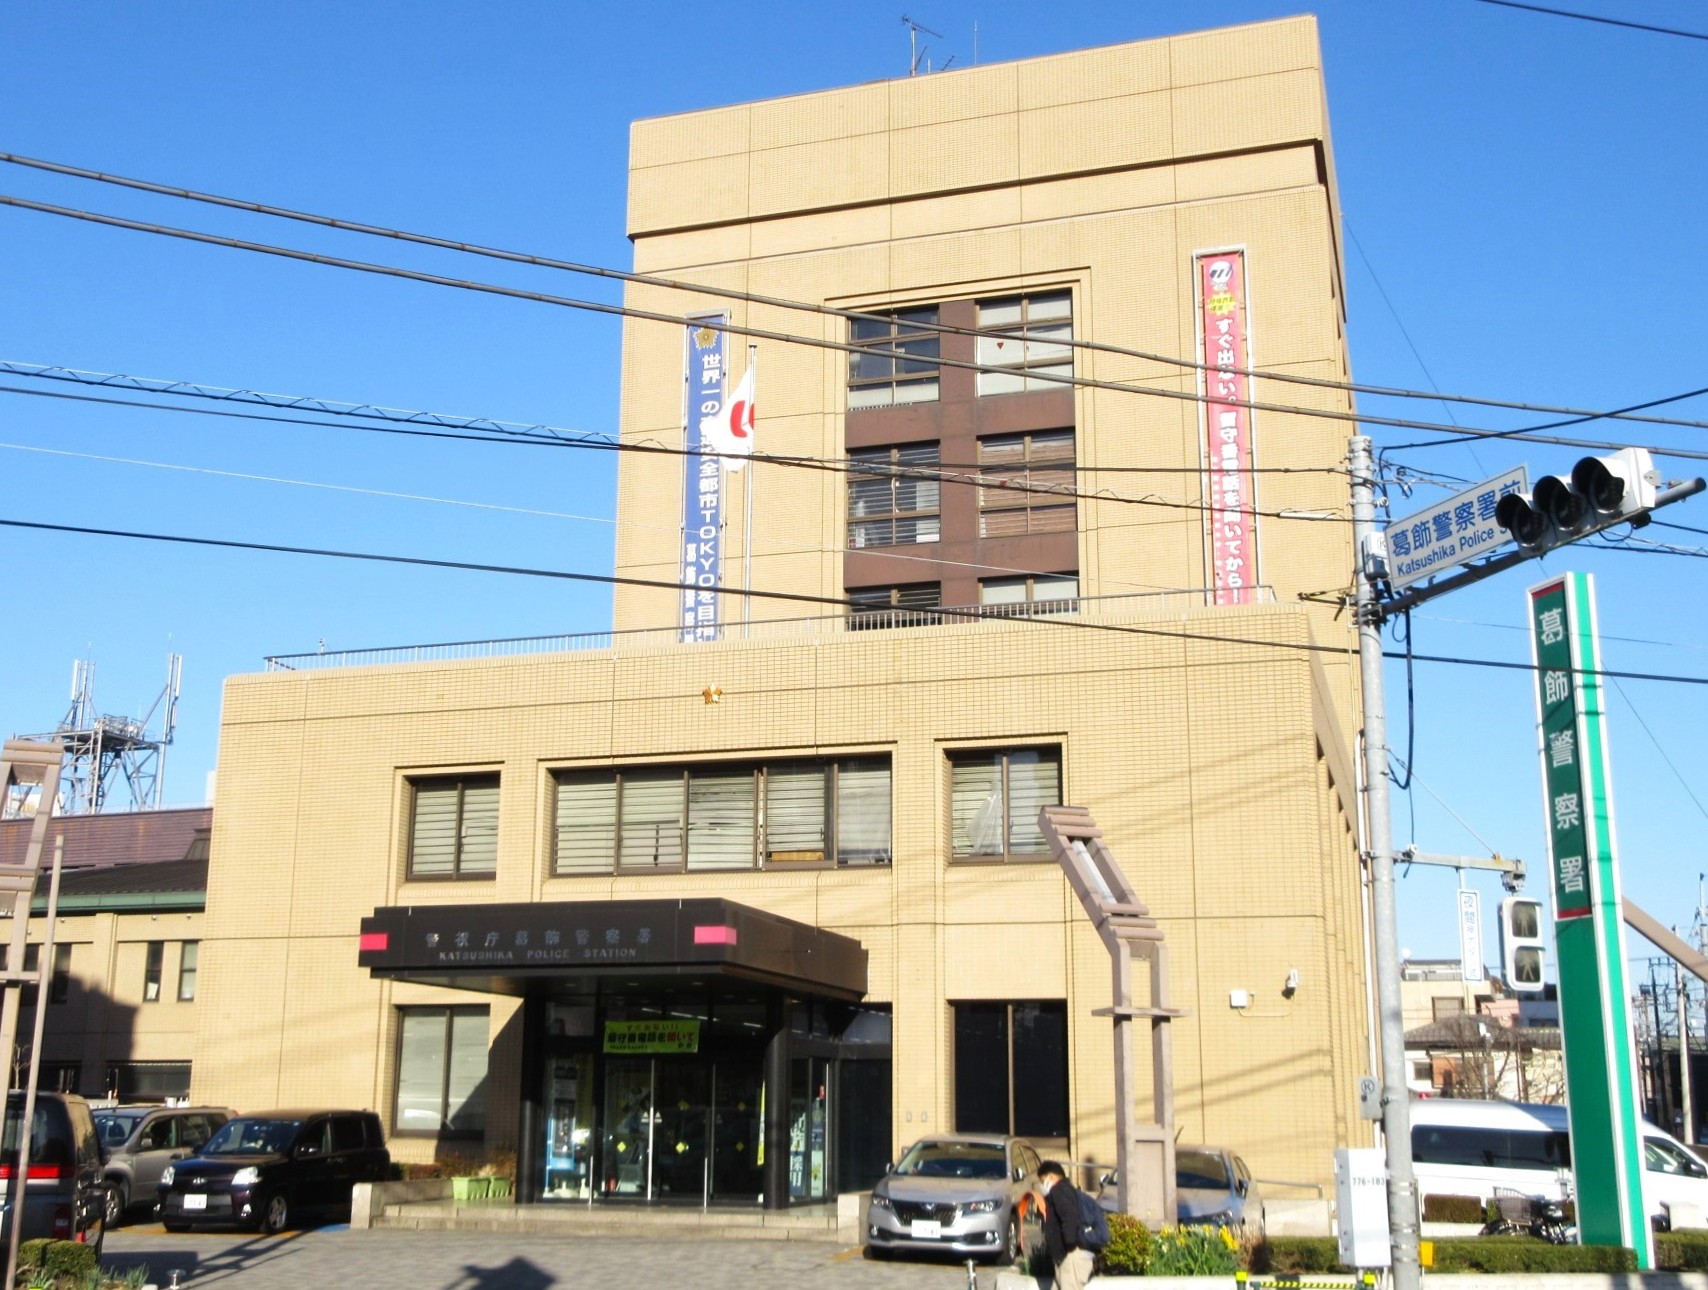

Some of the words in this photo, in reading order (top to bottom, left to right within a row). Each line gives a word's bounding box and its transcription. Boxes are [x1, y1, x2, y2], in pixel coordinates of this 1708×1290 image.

[1397, 543, 1456, 577] Katsushika
[1459, 527, 1495, 551] Police
[1539, 607, 1585, 894] 葛飾警察署
[439, 950, 514, 961] KATSUSHIKA
[527, 948, 570, 960] POLICE
[584, 947, 637, 959] STATION
